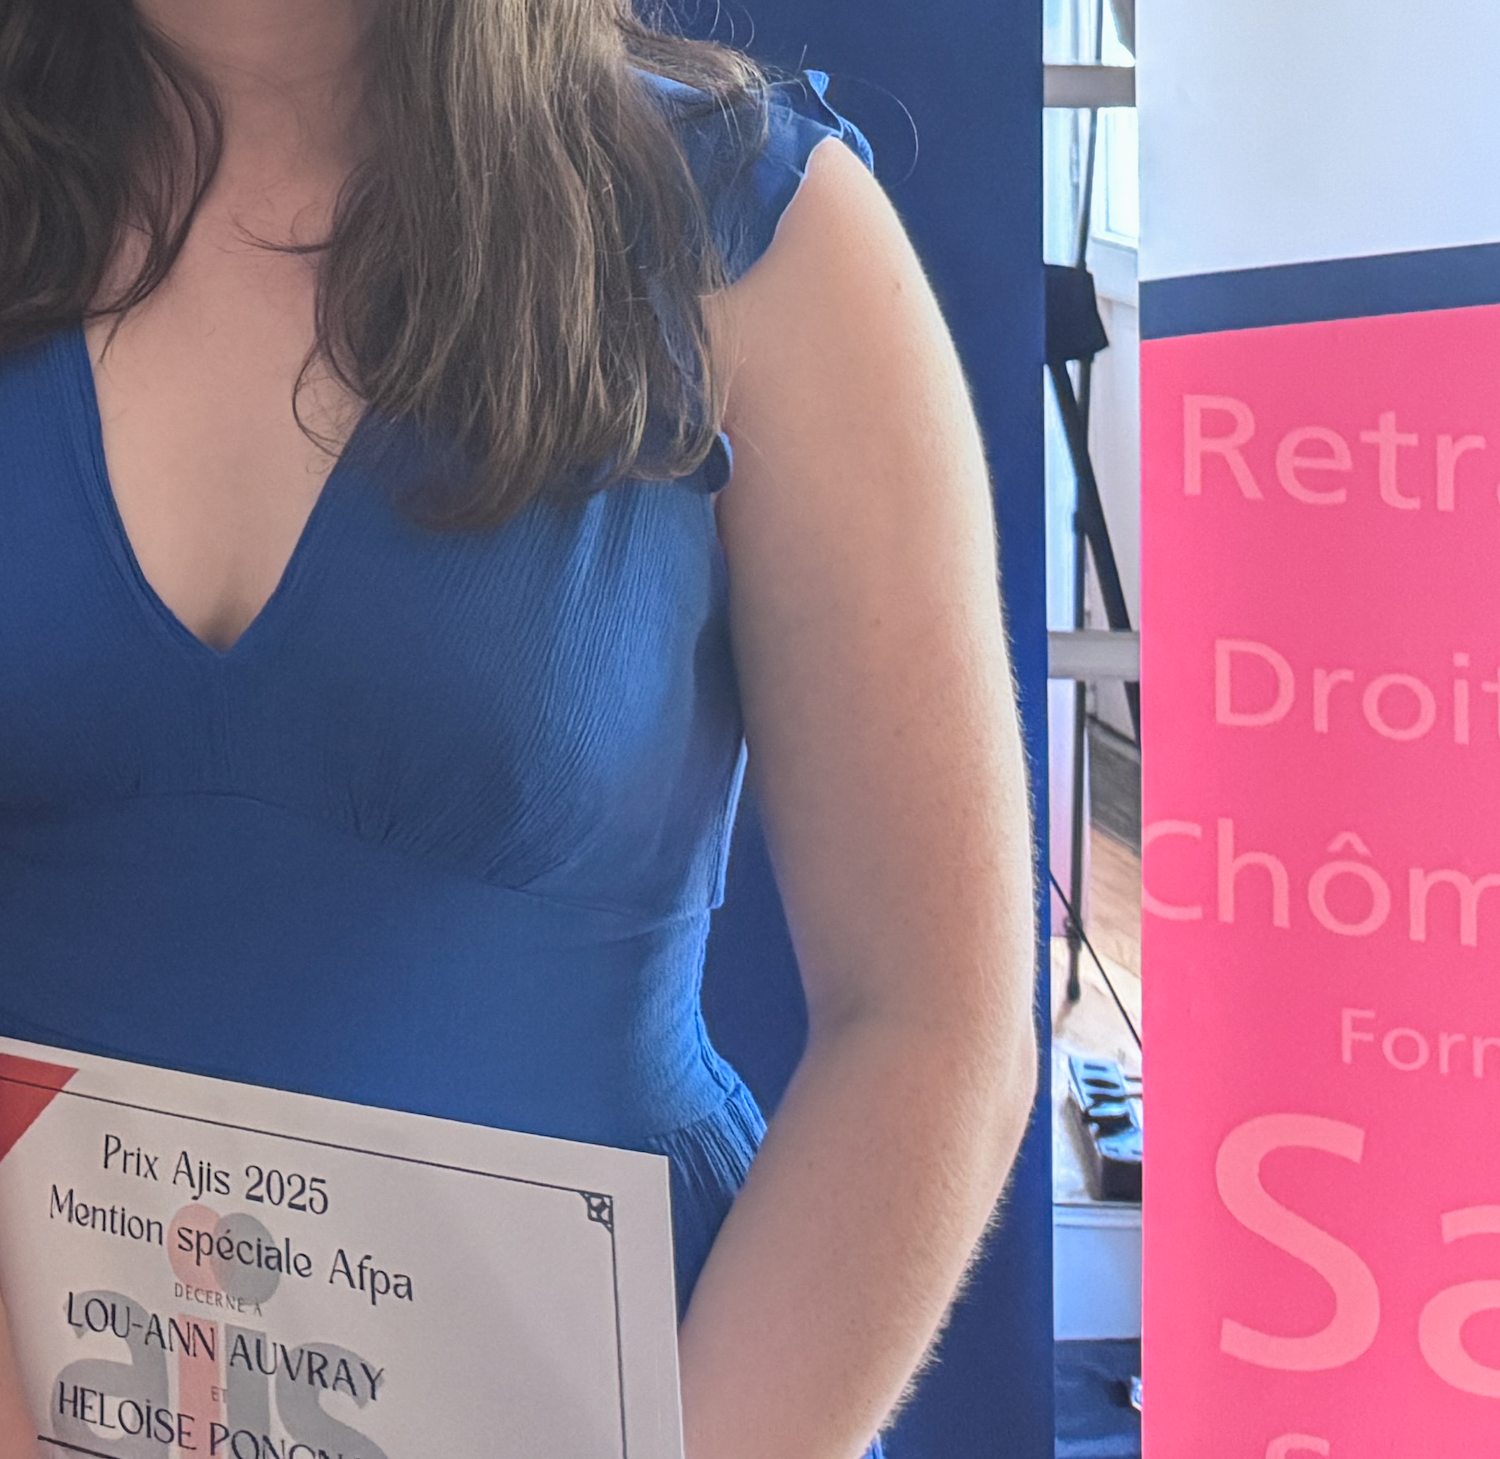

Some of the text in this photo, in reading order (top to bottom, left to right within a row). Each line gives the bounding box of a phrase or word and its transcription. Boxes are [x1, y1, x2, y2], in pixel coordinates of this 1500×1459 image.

[103, 1133, 329, 1215] Prix Ajis 2025
[49, 1183, 414, 1305] Mention spéciale Afpa
[66, 1291, 386, 1401] LOU-ANN AUVRAY
[210, 1386, 228, 1404] ET
